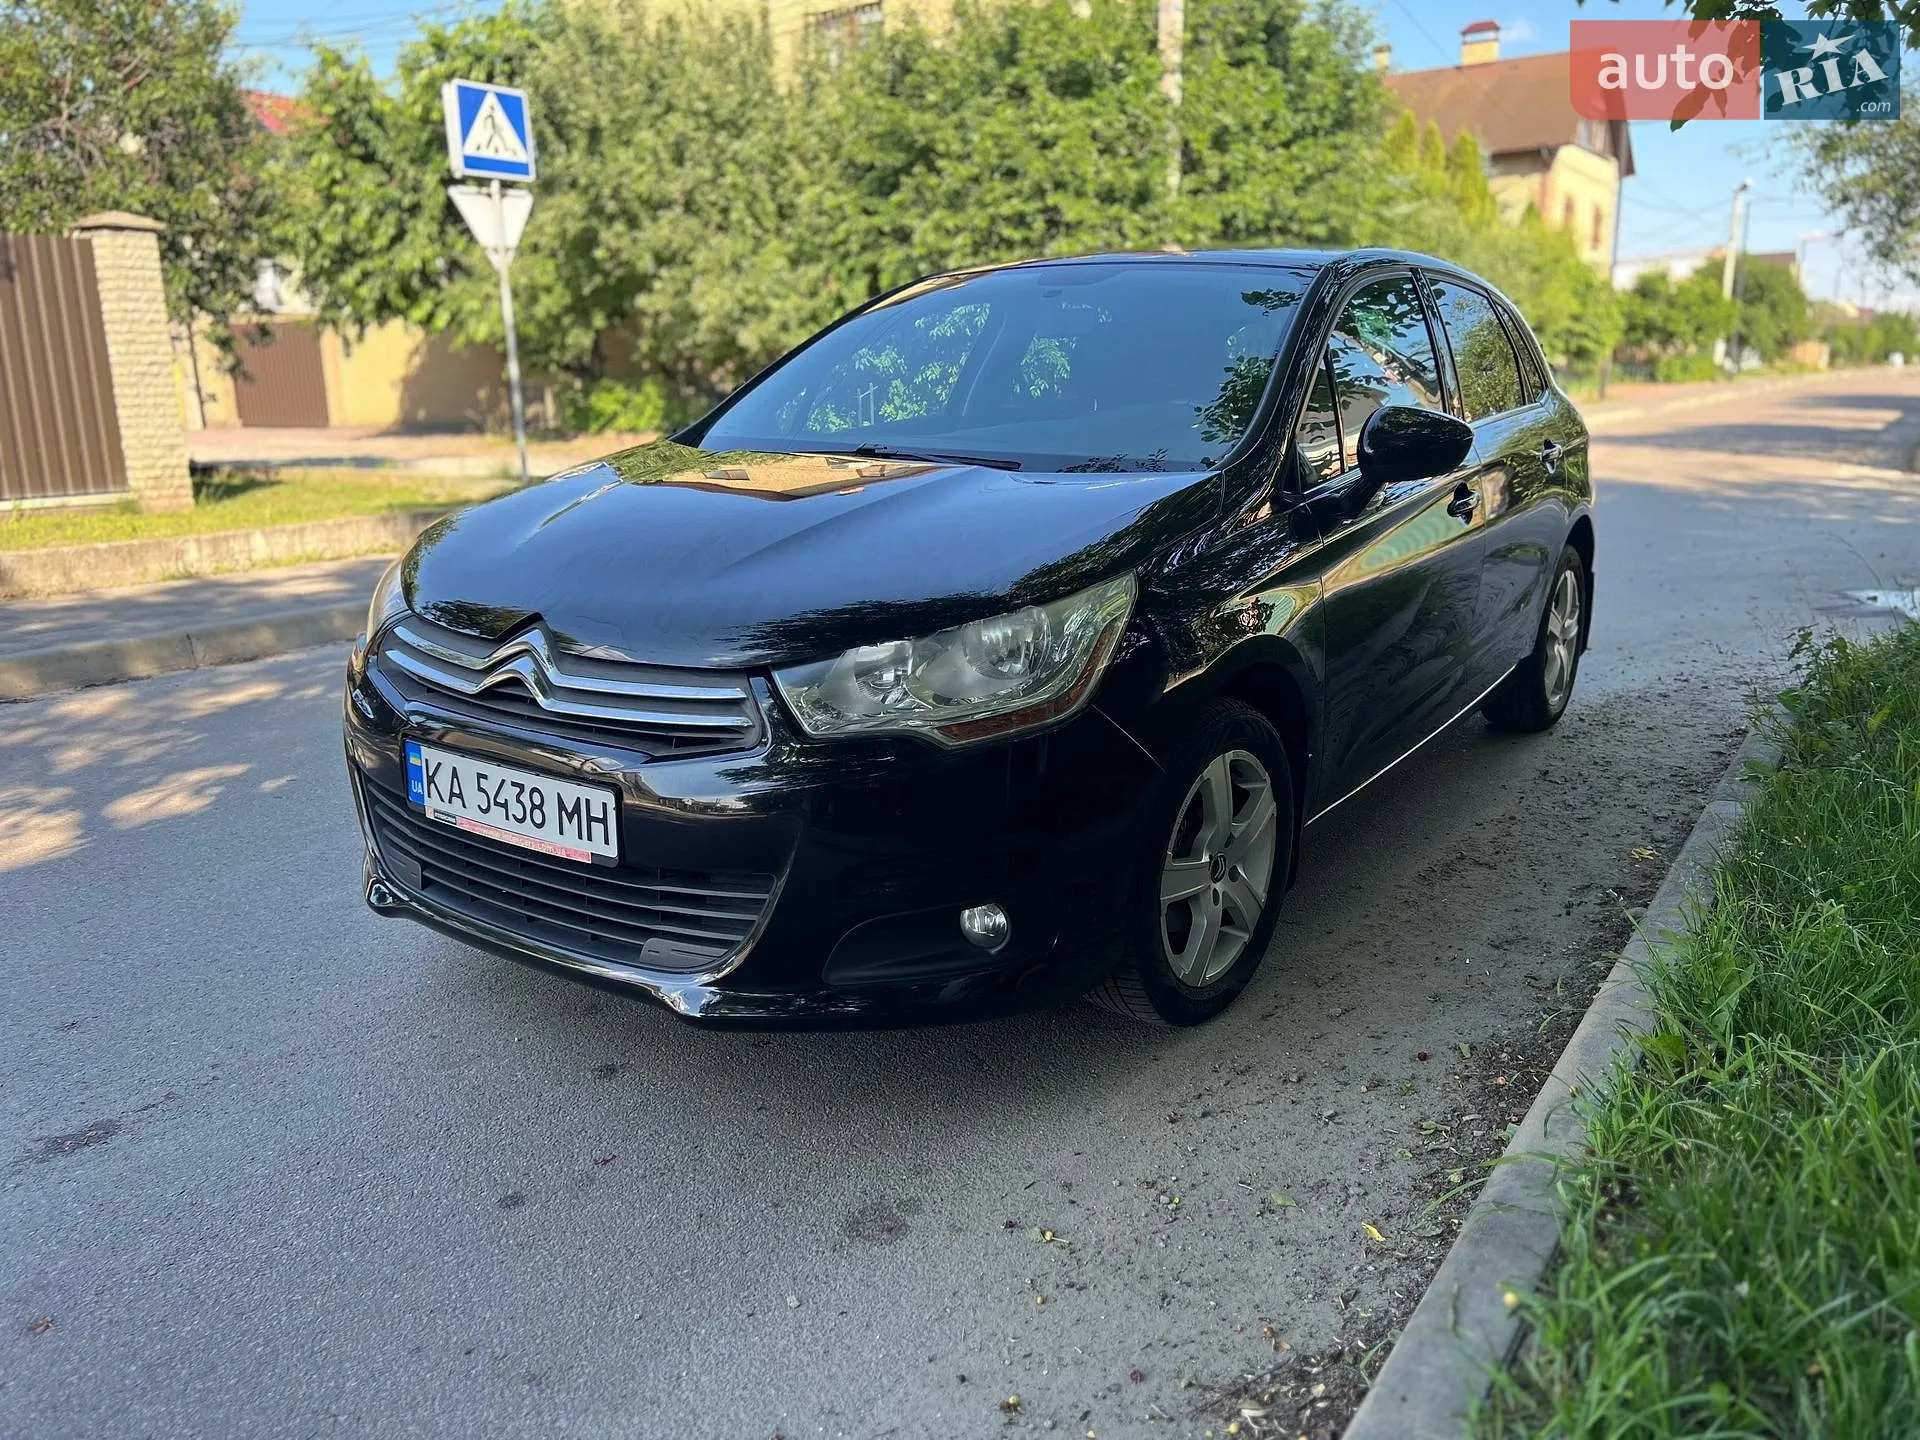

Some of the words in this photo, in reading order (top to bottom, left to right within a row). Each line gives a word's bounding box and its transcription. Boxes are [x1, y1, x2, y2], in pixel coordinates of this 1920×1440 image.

[411, 779, 424, 796] UA
[424, 758, 467, 809] KA
[476, 771, 546, 830] 5438
[556, 791, 610, 846] MH
